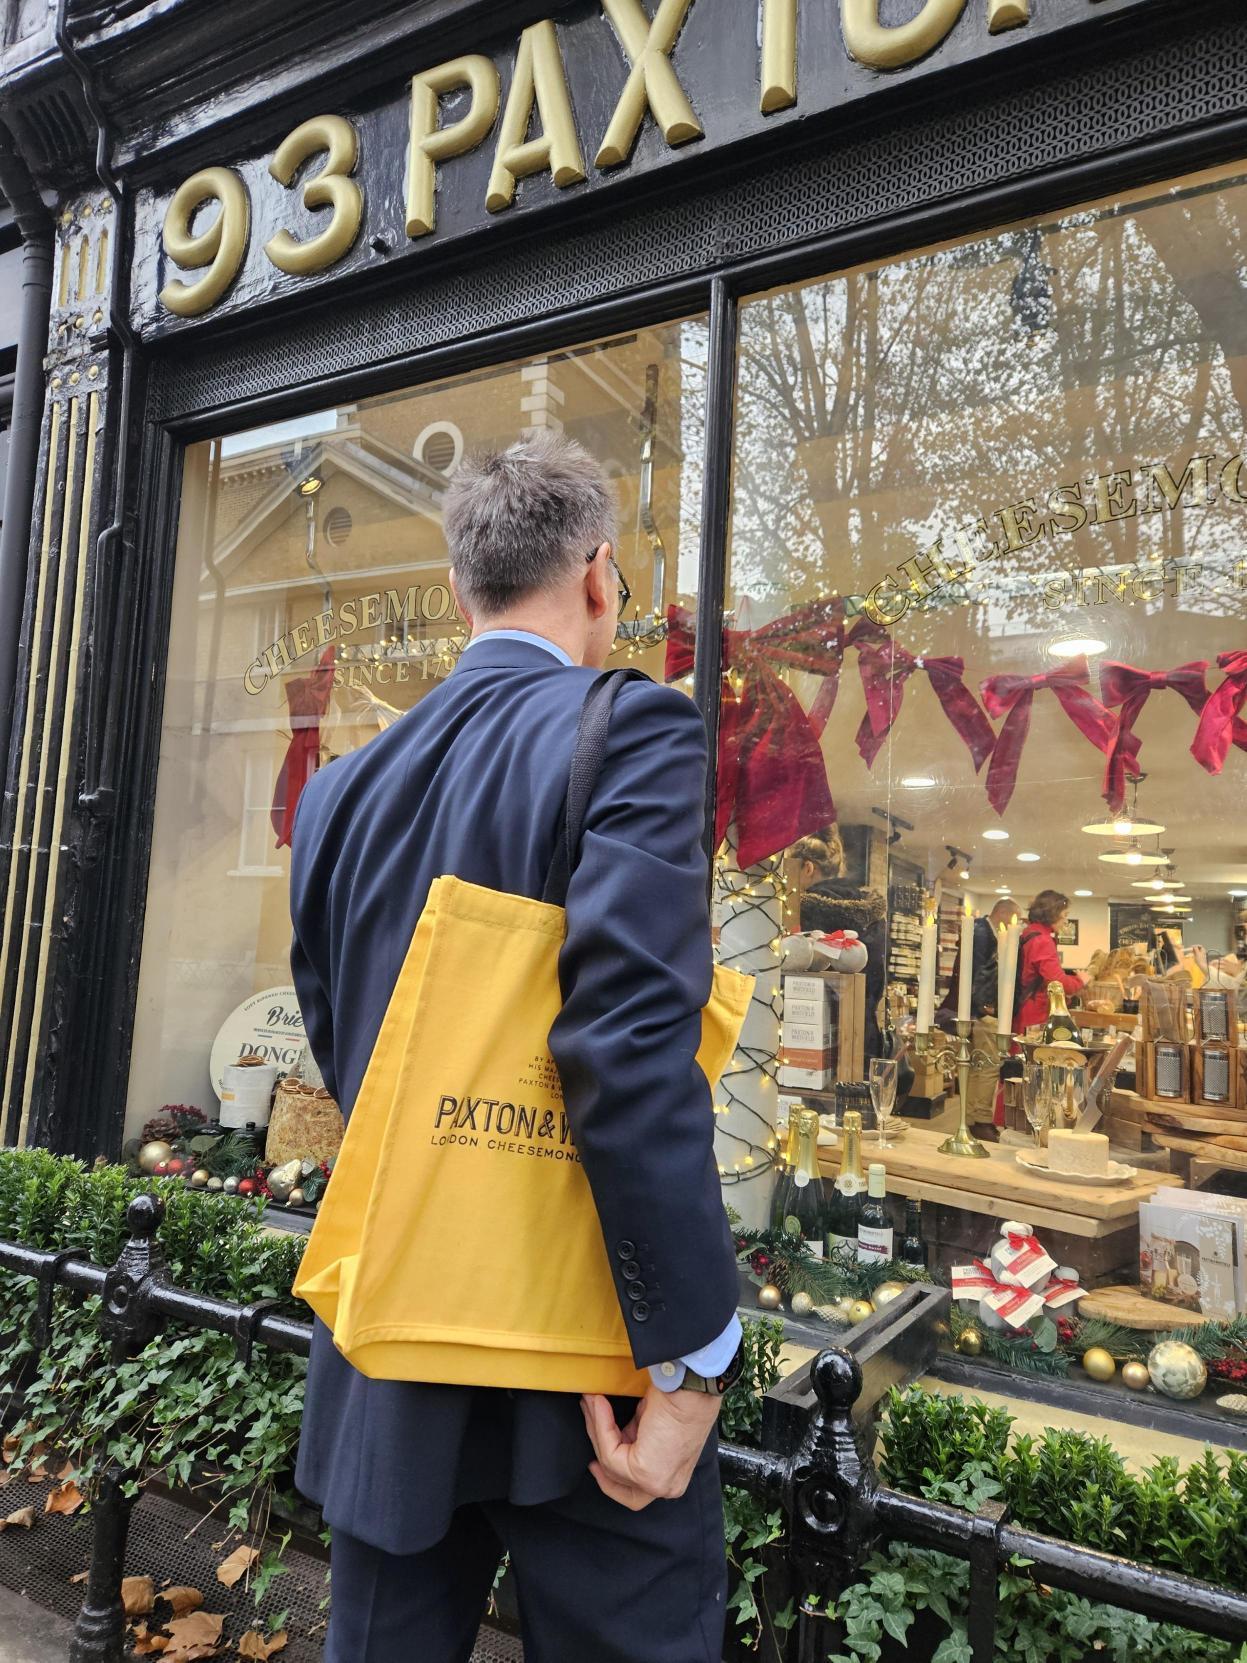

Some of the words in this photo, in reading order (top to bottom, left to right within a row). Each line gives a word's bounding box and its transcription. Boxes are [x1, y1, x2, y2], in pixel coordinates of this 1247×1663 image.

[158, 113, 364, 319] 93
[404, 0, 1030, 238] PAX
[1042, 564, 1203, 610] SINCE
[333, 661, 410, 688] SINCE
[431, 1134, 479, 1147] LODON
